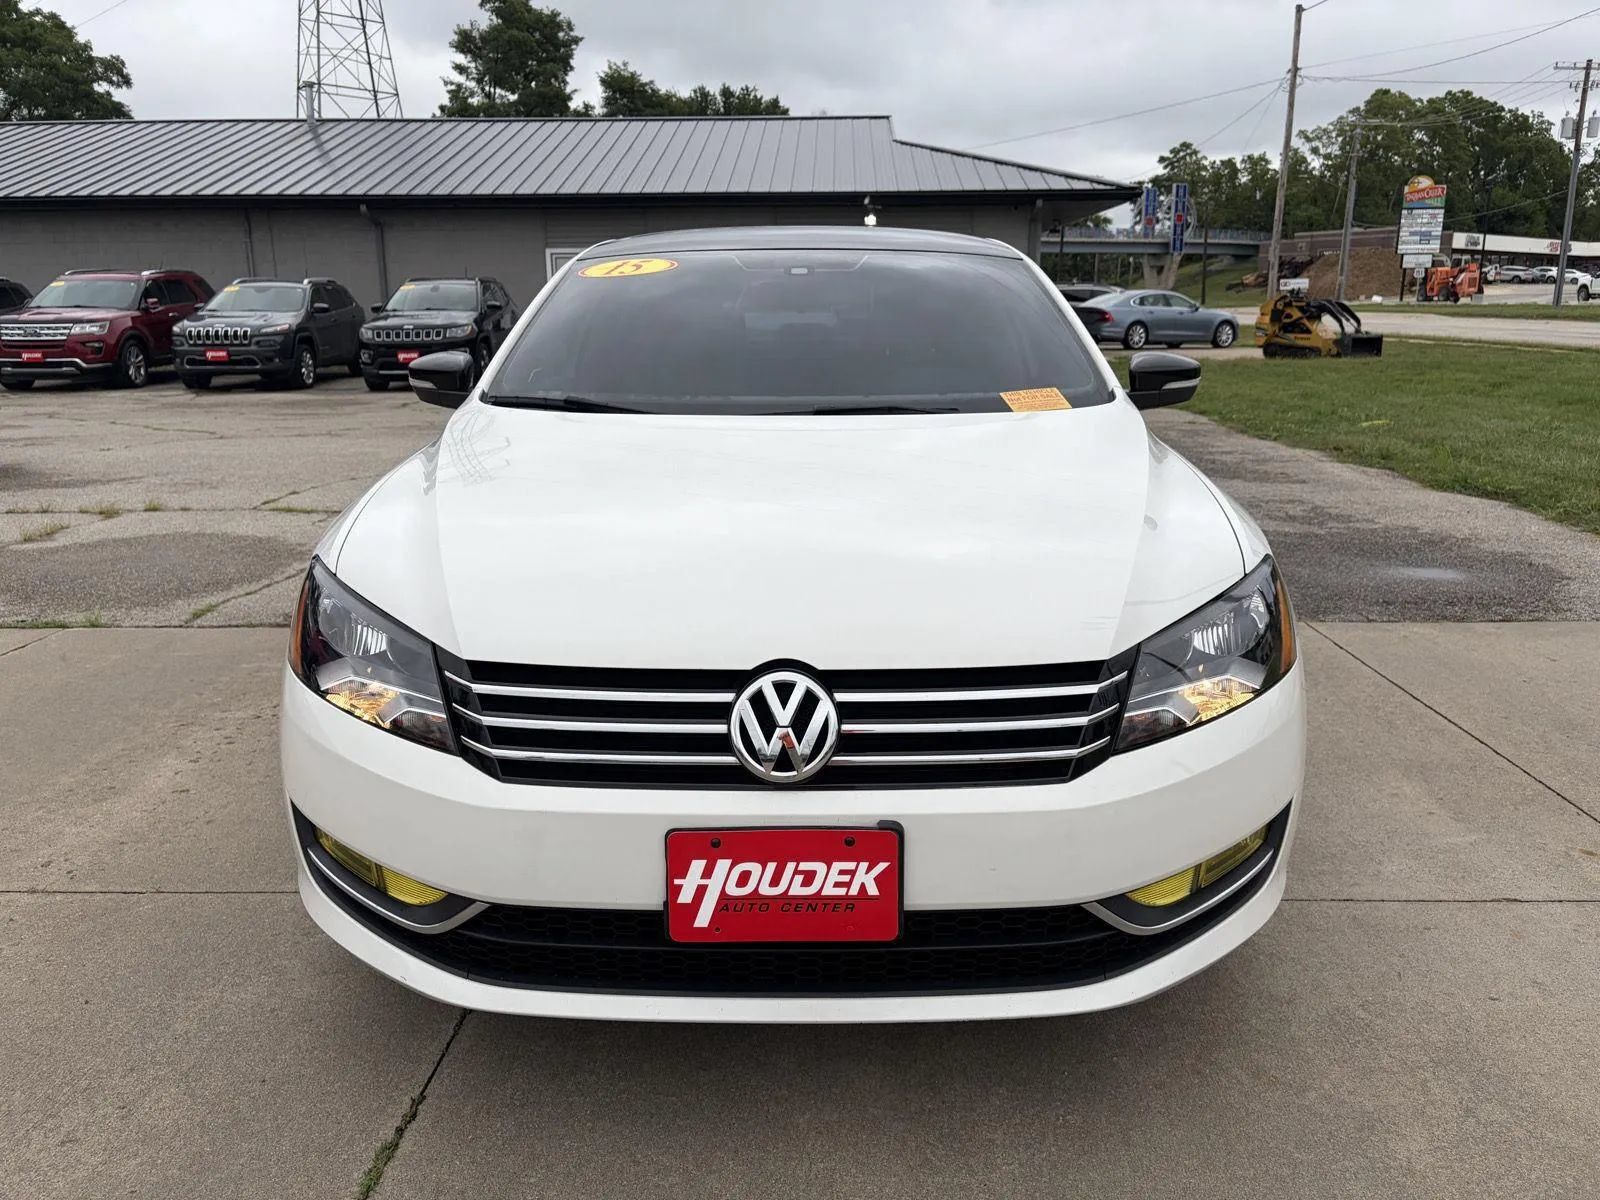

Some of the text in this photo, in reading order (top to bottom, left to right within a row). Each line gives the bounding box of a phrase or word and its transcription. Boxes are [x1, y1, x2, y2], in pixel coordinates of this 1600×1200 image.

[673, 858, 892, 928] HOUDEK
[719, 902, 856, 913] AUTO CENTER
